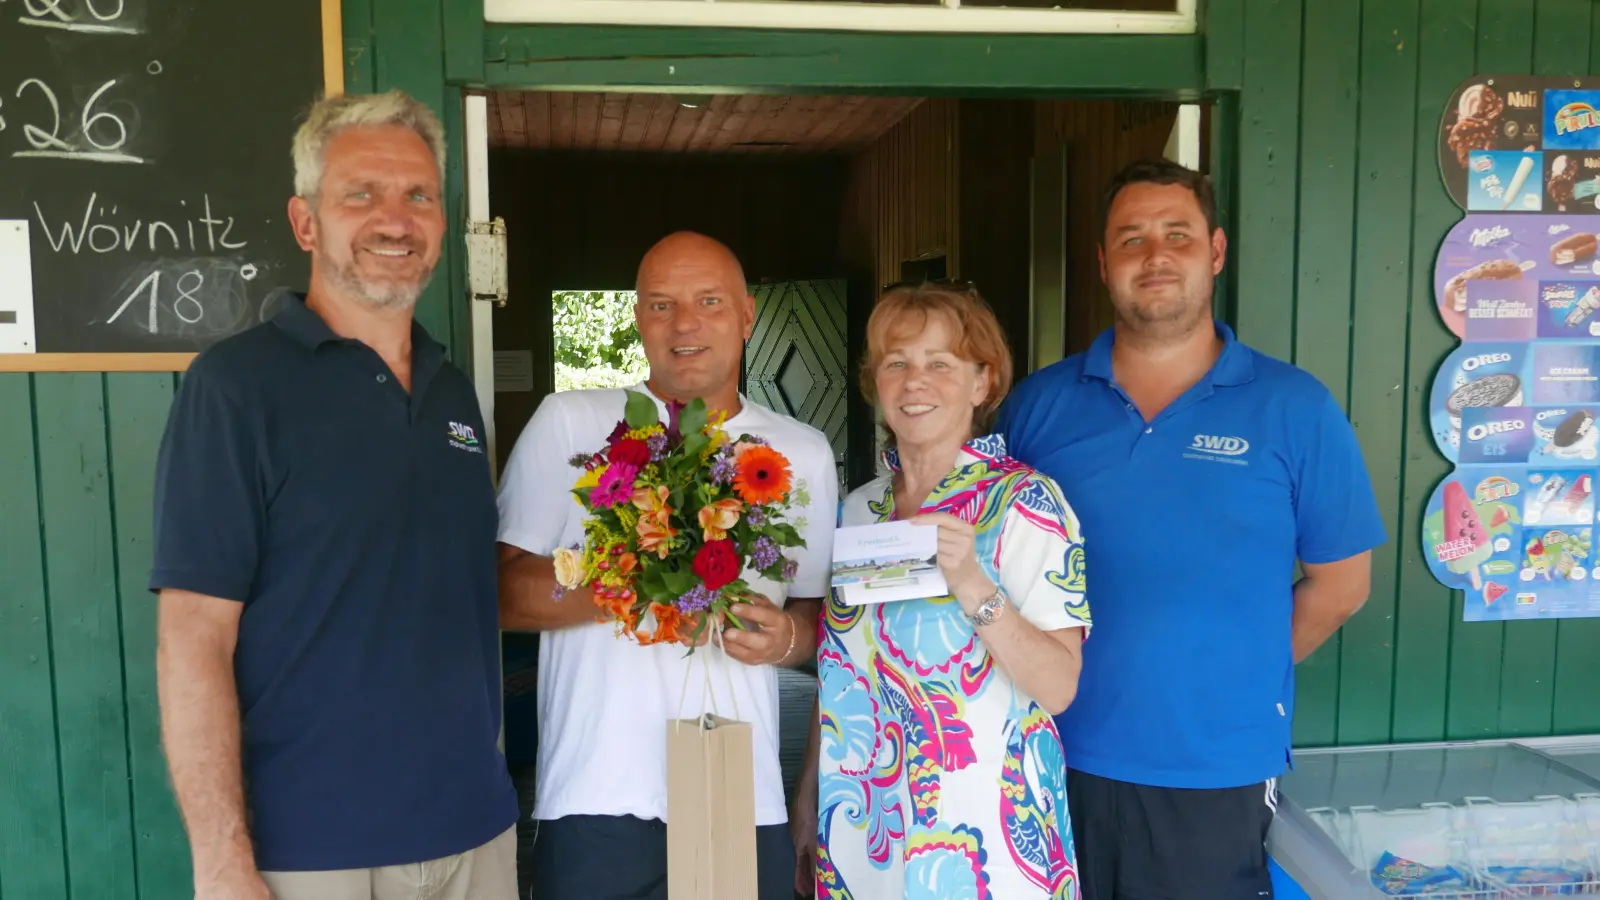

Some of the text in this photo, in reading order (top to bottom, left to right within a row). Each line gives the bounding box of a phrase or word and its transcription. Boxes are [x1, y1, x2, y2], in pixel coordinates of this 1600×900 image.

[33, 192, 248, 254] Wörnitz
[1462, 353, 1512, 371] OREO
[448, 421, 475, 439] SWD
[1467, 419, 1525, 441] OREO
[1192, 434, 1240, 451] SWD
[1483, 443, 1507, 456] EIS
[1435, 538, 1472, 554] WATER
[1439, 544, 1476, 562] MELON
